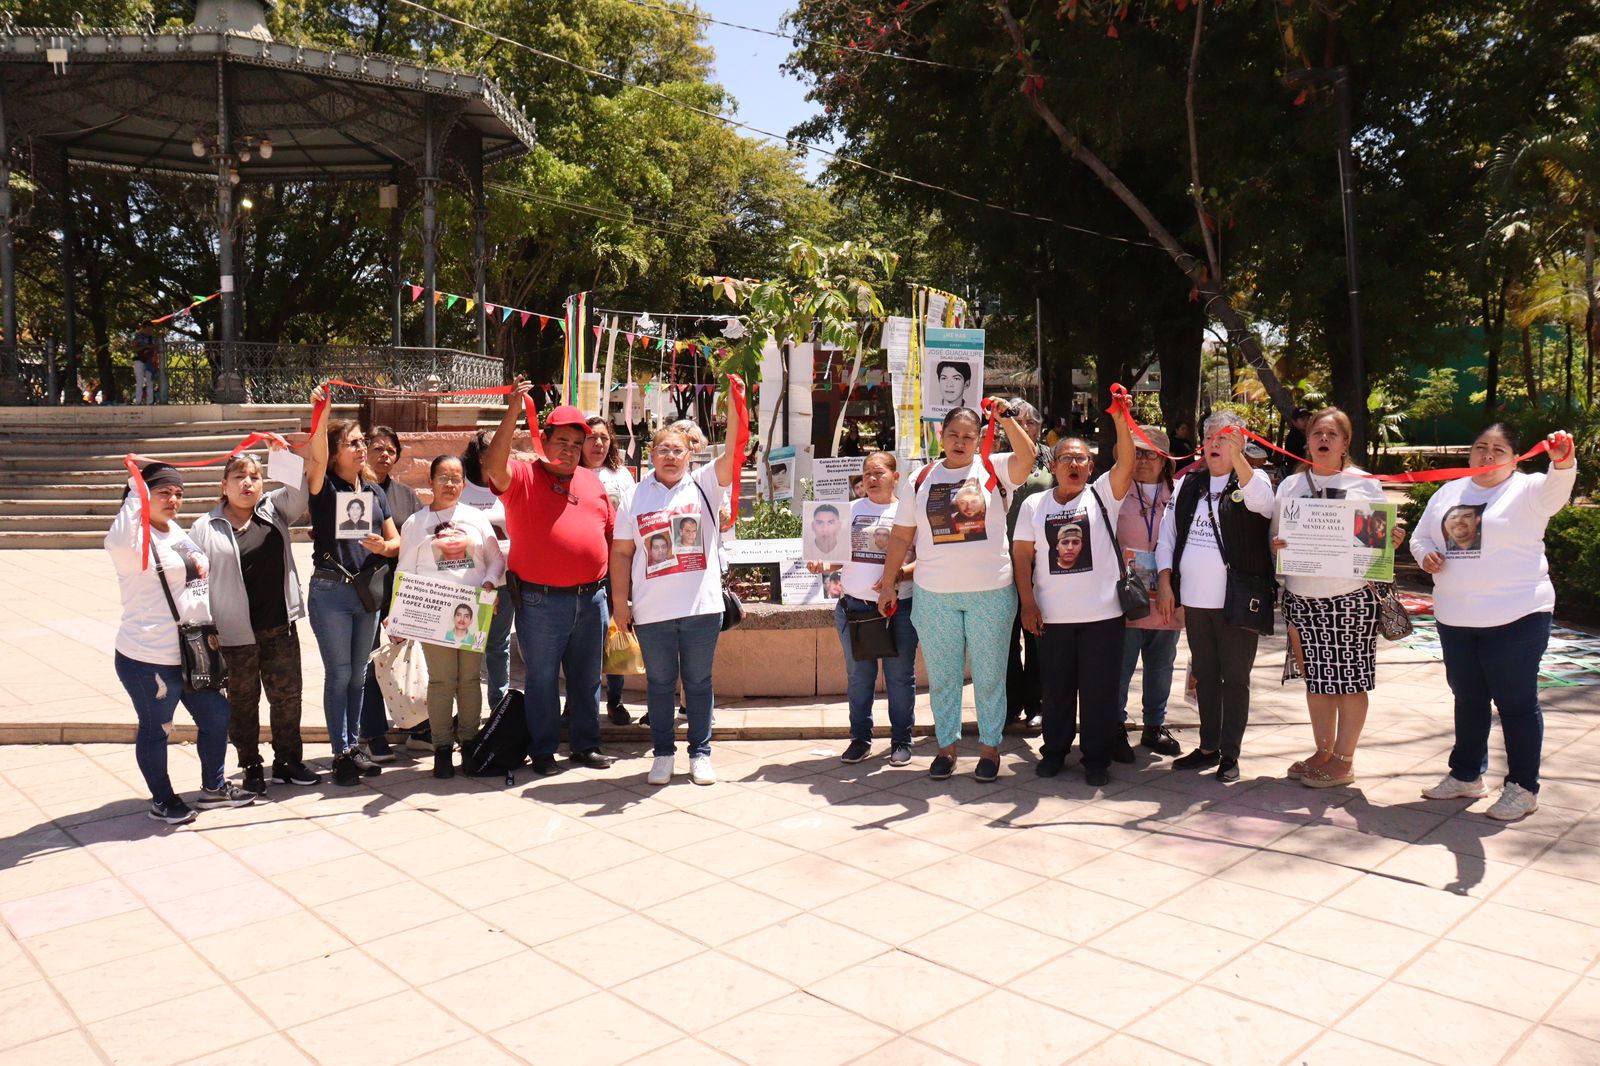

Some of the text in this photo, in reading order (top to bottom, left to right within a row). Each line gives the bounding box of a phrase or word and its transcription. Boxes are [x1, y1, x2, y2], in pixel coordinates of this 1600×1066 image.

[398, 576, 425, 586] Colectivo
[434, 583, 454, 592] Padres
[395, 592, 452, 607] GERARDO ALBERTO
[429, 589, 471, 602] Desaparecidos
[403, 599, 421, 607] LOPEZ
